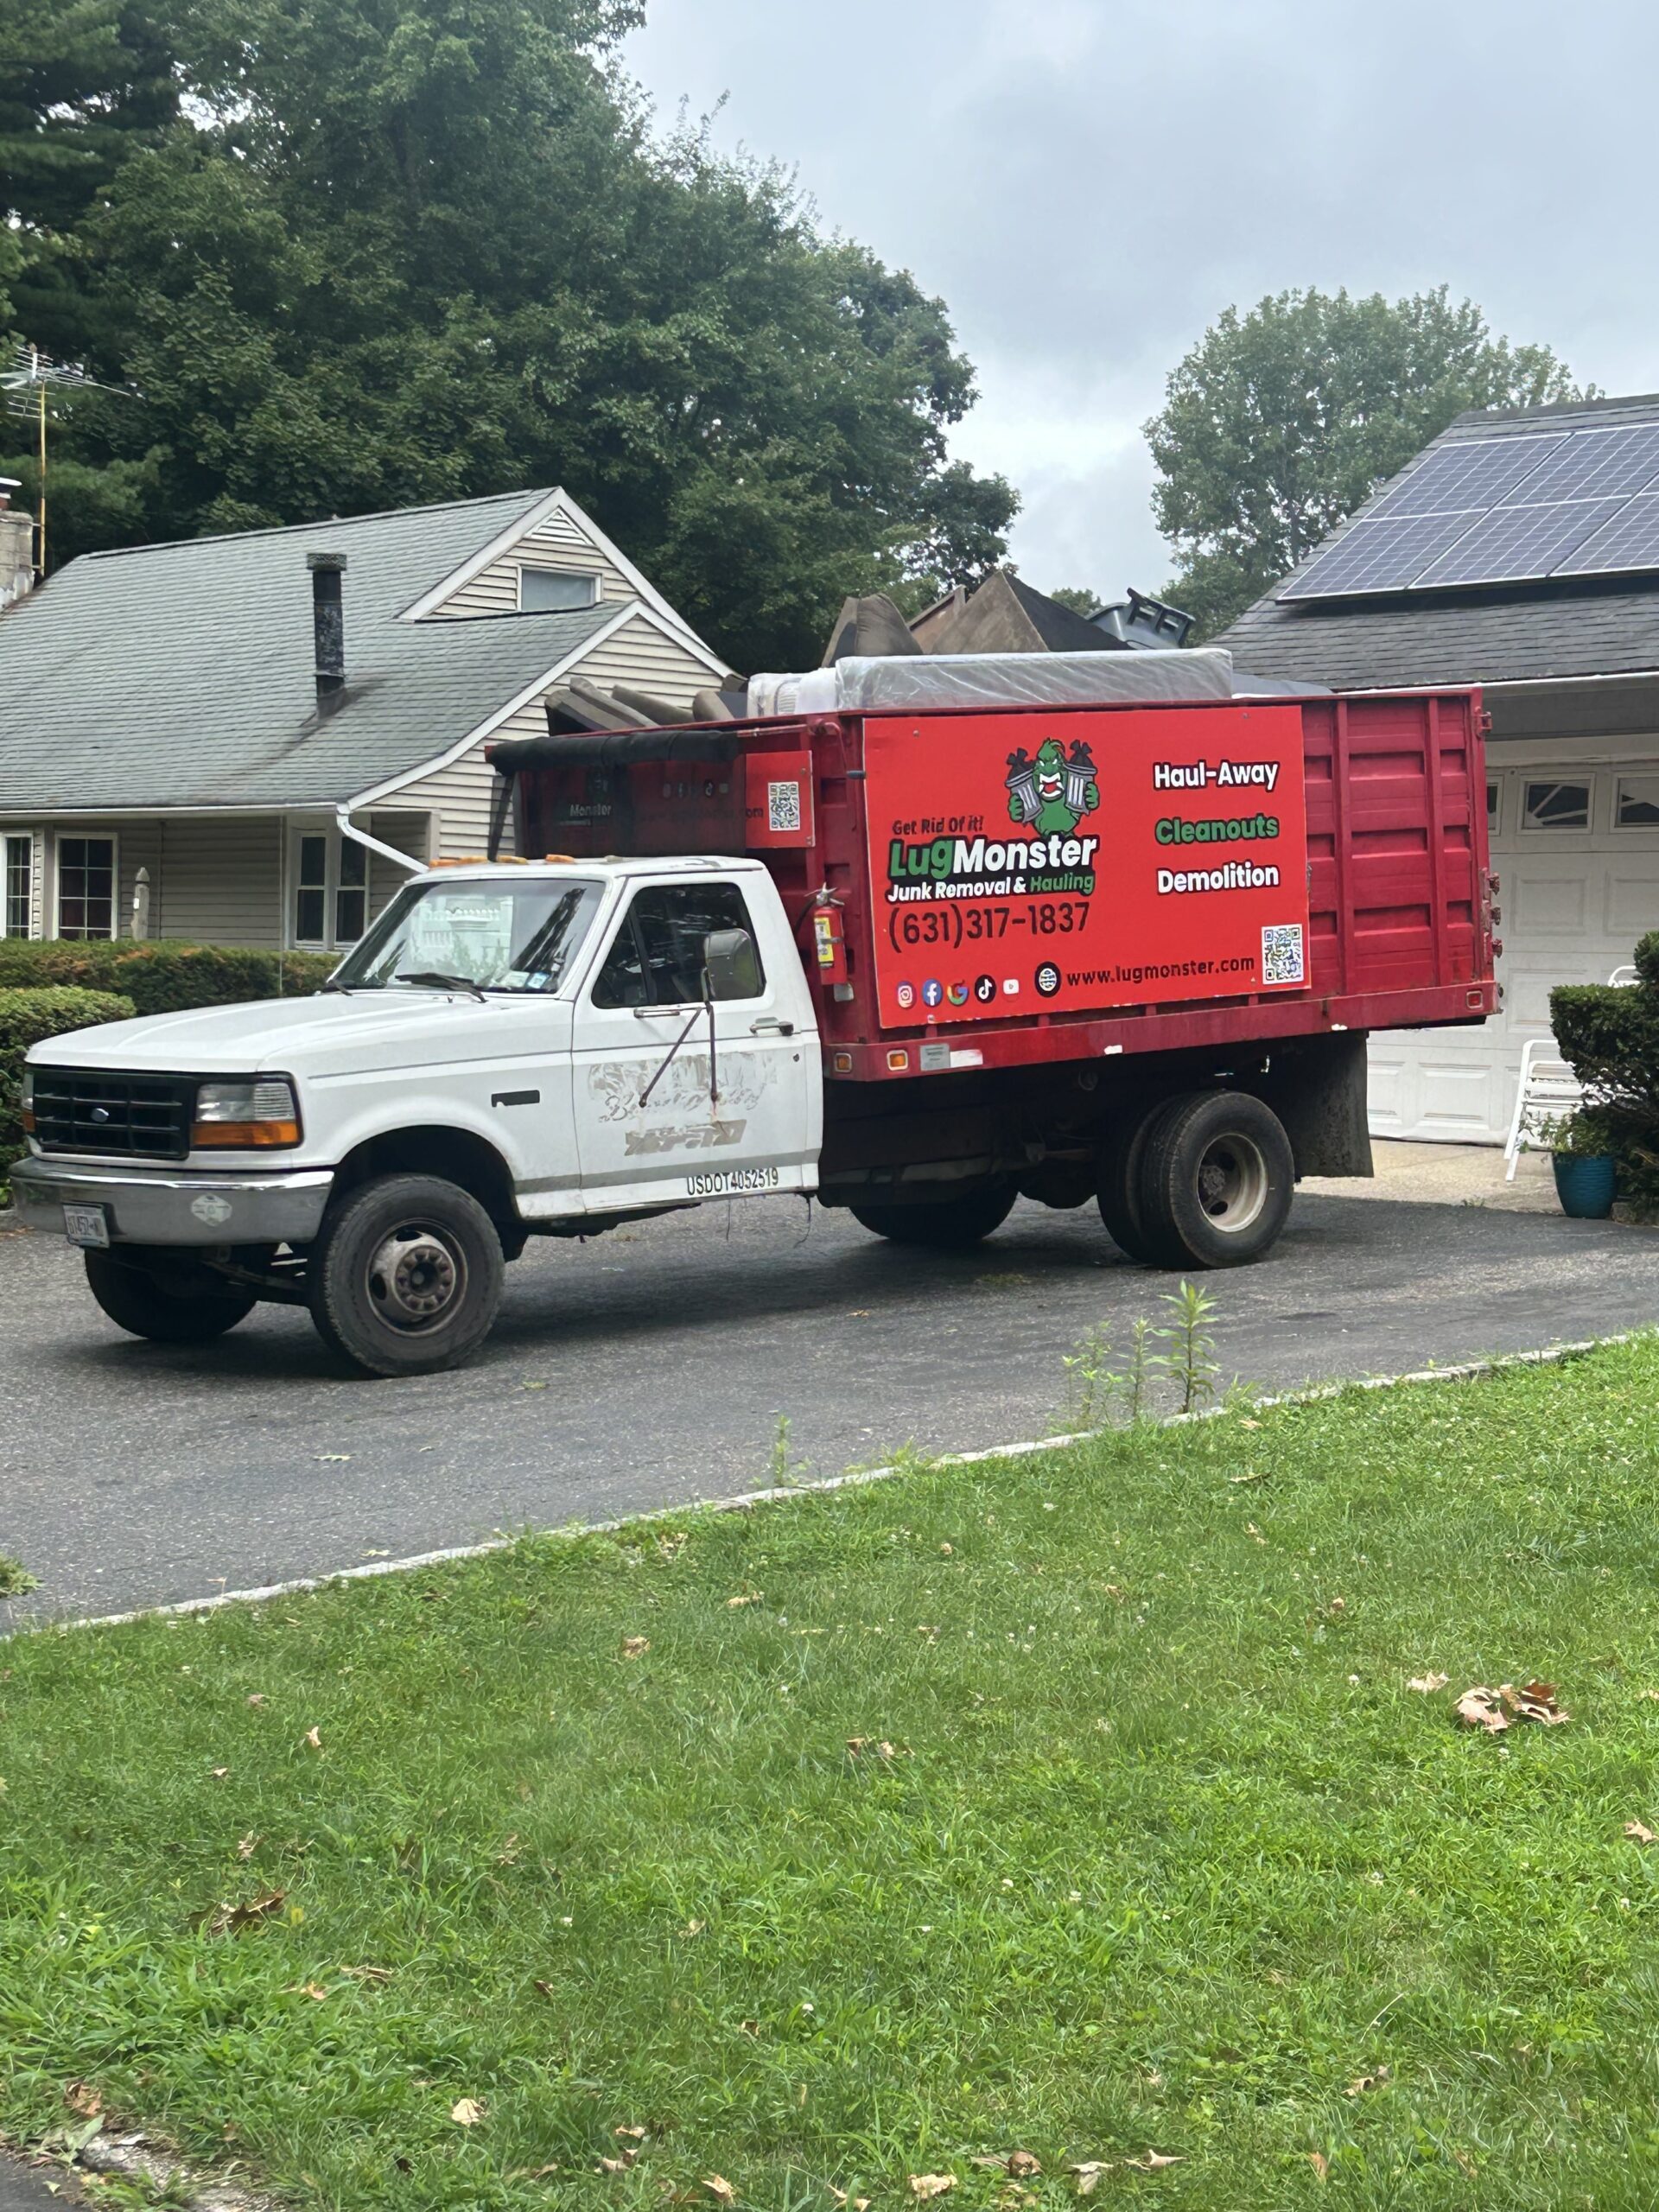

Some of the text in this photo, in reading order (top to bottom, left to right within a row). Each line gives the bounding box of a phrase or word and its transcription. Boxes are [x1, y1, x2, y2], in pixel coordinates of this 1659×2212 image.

[1154, 761, 1279, 791] Haul-Away
[892, 820, 917, 836] Get
[921, 817, 944, 834] Rid
[950, 815, 965, 832] Of
[1155, 816, 1279, 843] Cleanouts
[890, 834, 1097, 880] LugMonster
[887, 871, 1095, 902] Junk Removal & Hauling
[1157, 861, 1280, 893] Demolition
[888, 901, 1090, 954] (631)317-1837
[1066, 957, 1255, 986] www.lugmonster.com
[687, 1166, 779, 1196] USDOT4052519
